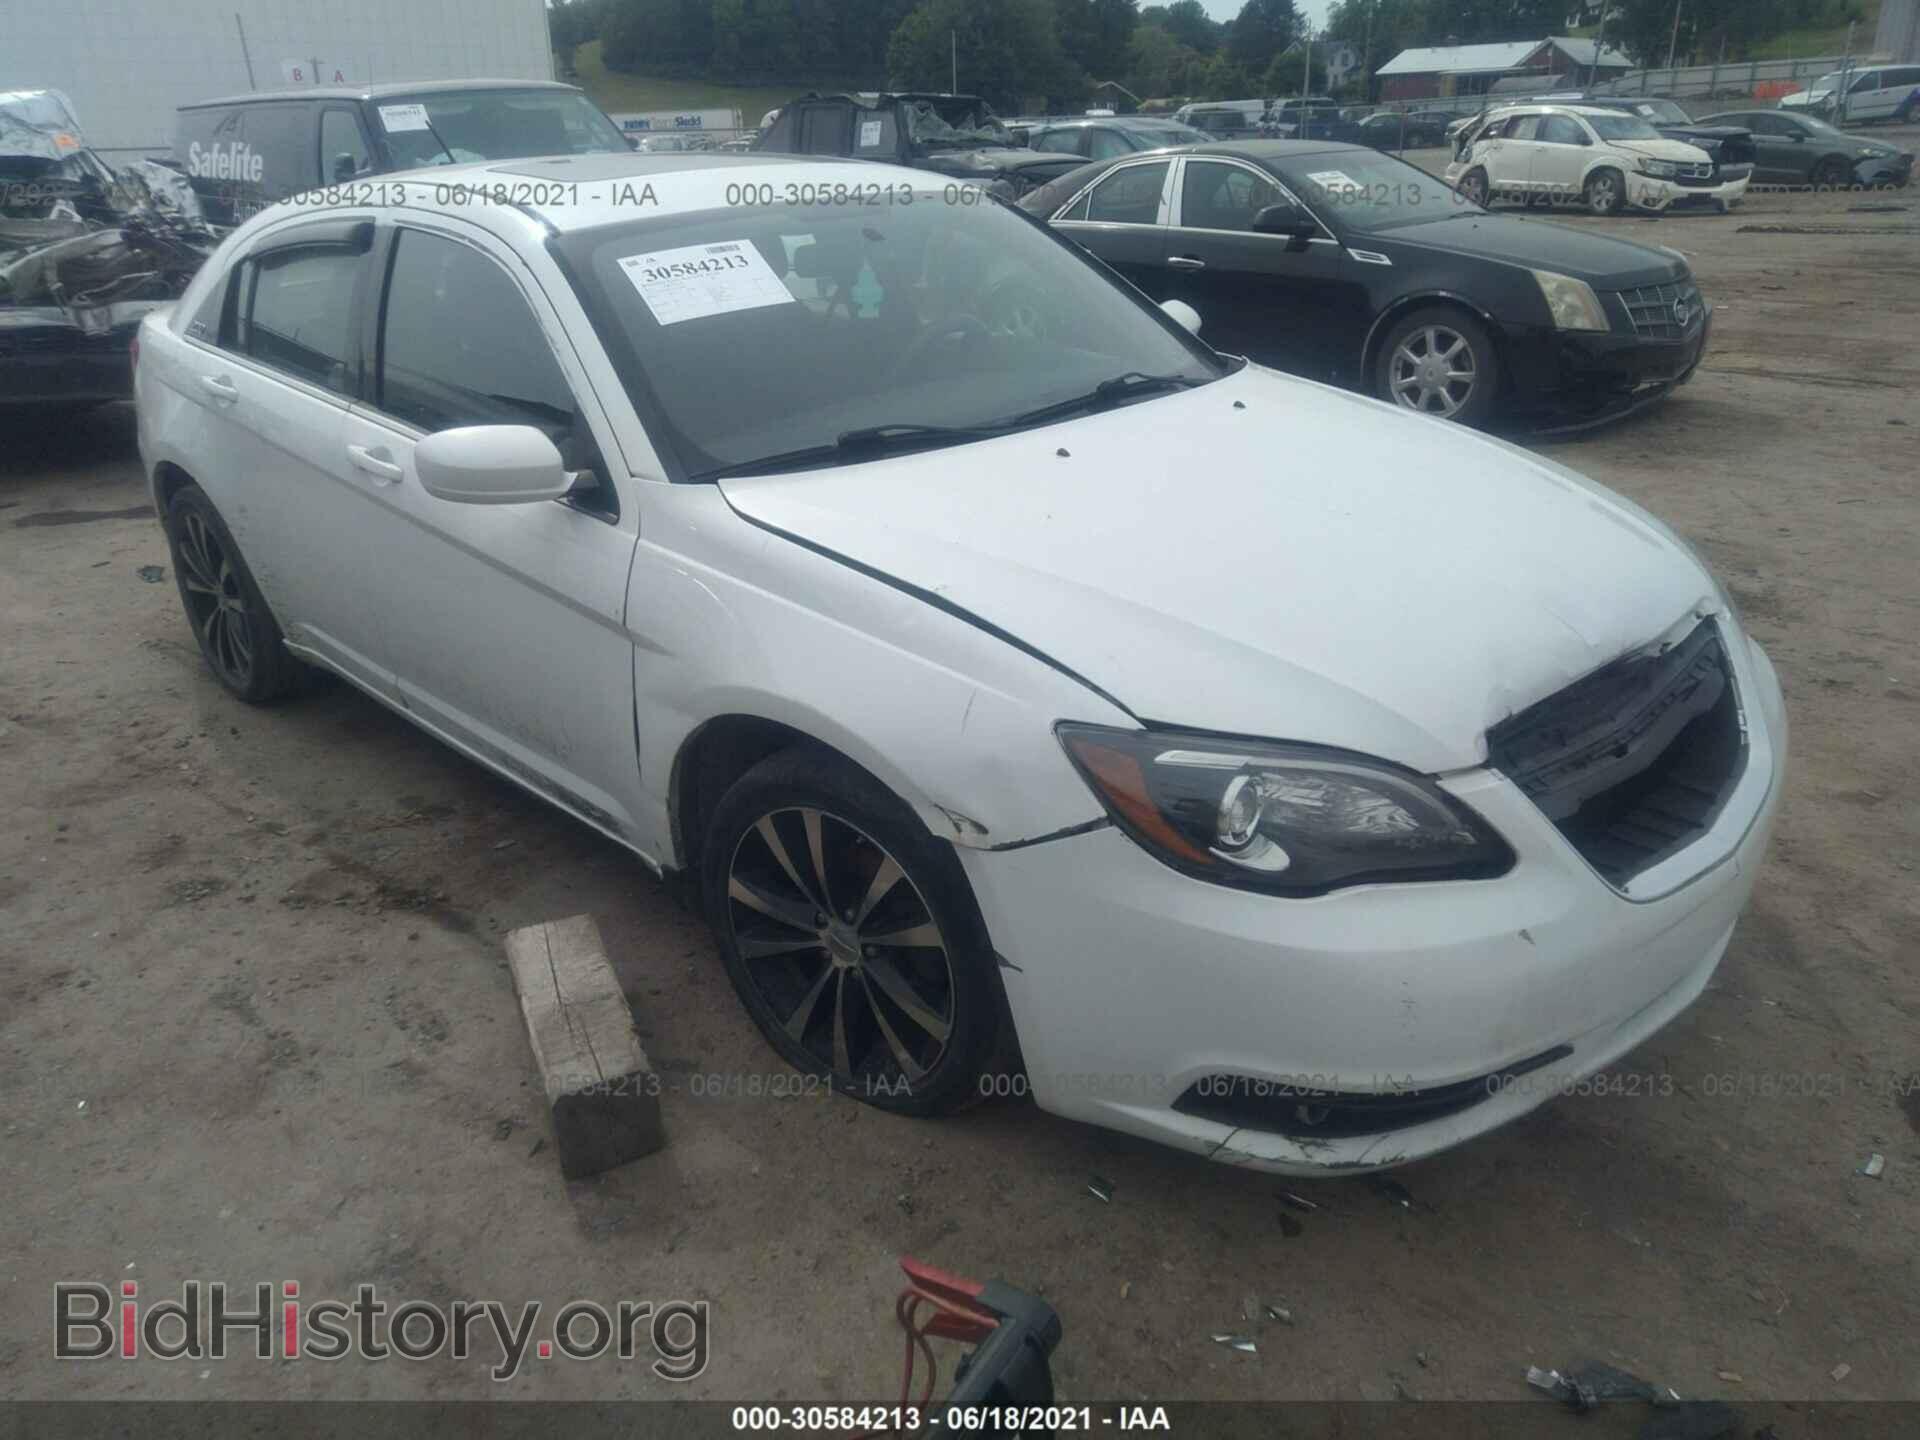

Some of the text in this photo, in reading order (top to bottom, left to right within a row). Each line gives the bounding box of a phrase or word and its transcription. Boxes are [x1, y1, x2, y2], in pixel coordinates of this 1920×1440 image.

[292, 67, 303, 82] B
[334, 69, 345, 83] A
[188, 140, 264, 183] Safelite
[641, 254, 750, 282] 30584213
